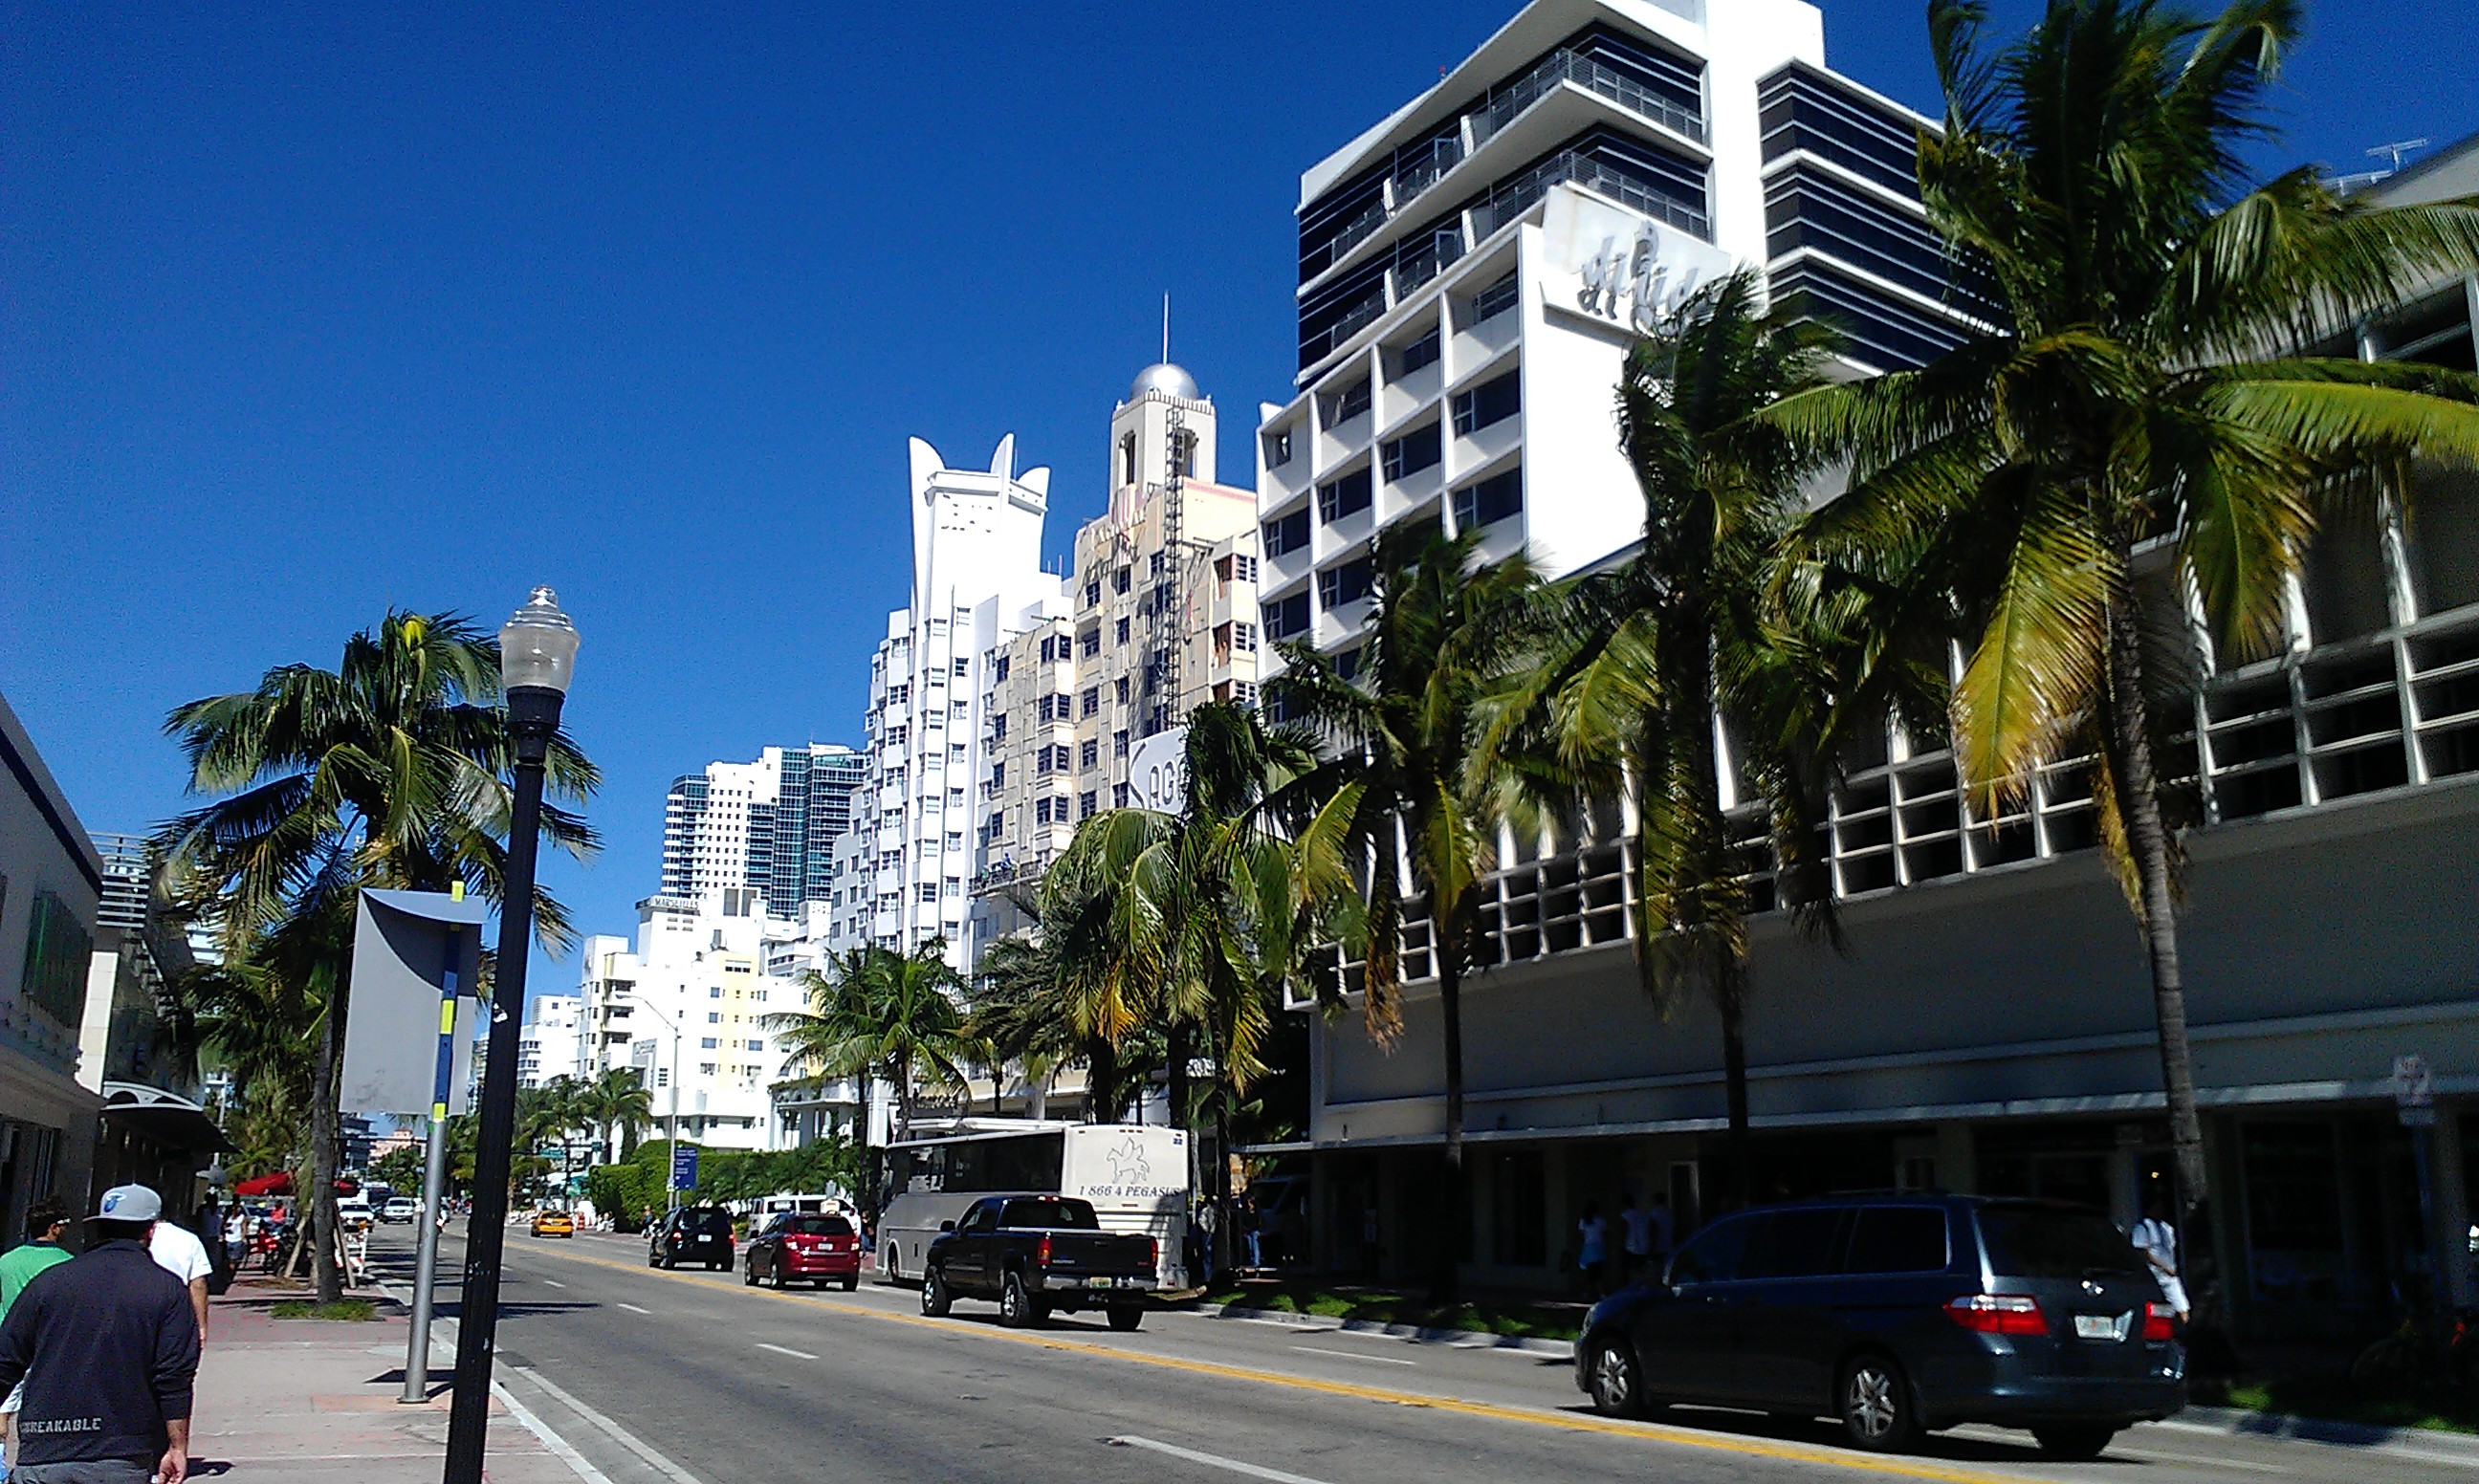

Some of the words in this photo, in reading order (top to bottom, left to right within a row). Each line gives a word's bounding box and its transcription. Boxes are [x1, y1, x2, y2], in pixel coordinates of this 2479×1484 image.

[1079, 1185, 1086, 1196] 1
[1087, 1185, 1112, 1197] 866
[1114, 1185, 1122, 1196] 4
[1125, 1186, 1181, 1198] PEGASUS
